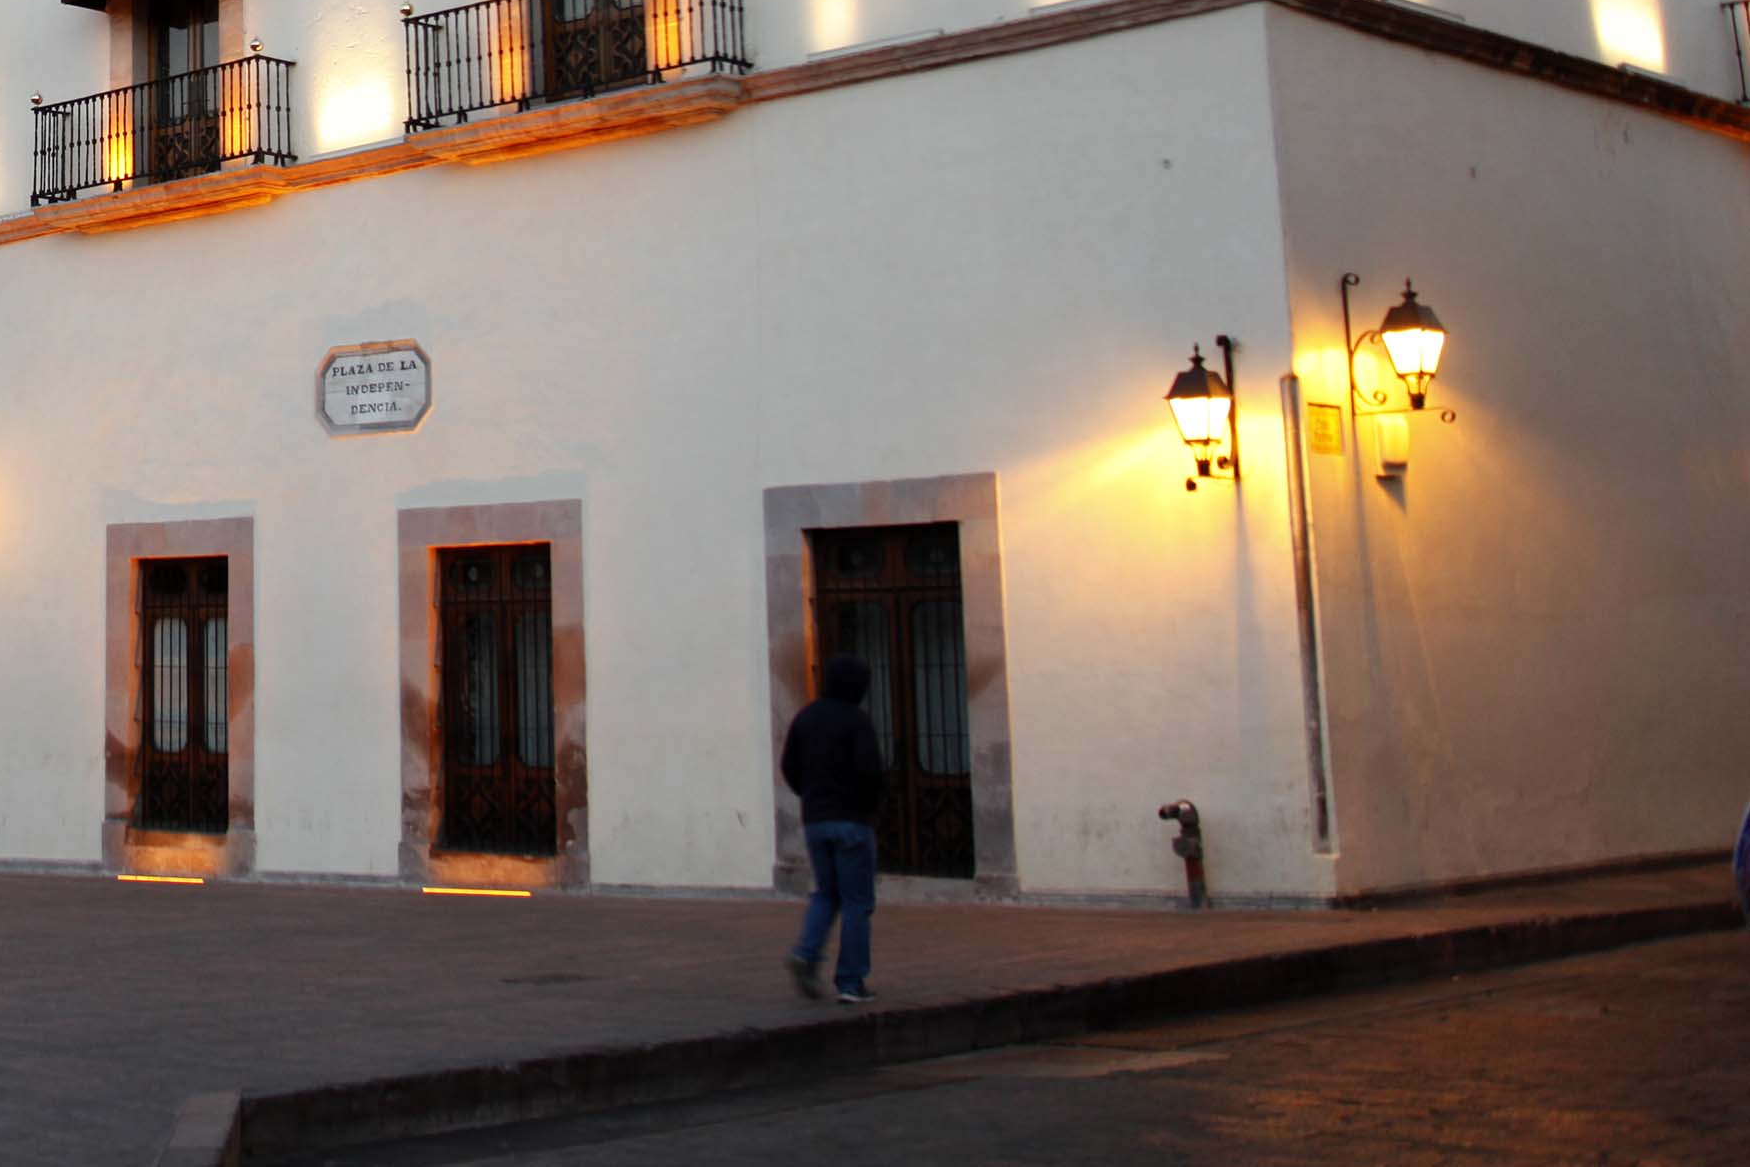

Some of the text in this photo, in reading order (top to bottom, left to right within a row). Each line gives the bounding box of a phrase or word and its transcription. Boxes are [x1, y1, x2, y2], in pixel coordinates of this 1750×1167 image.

[331, 360, 417, 377] PLAZA DE LA
[346, 381, 410, 395] INDEPEN-
[351, 401, 401, 415] DENCIA.
